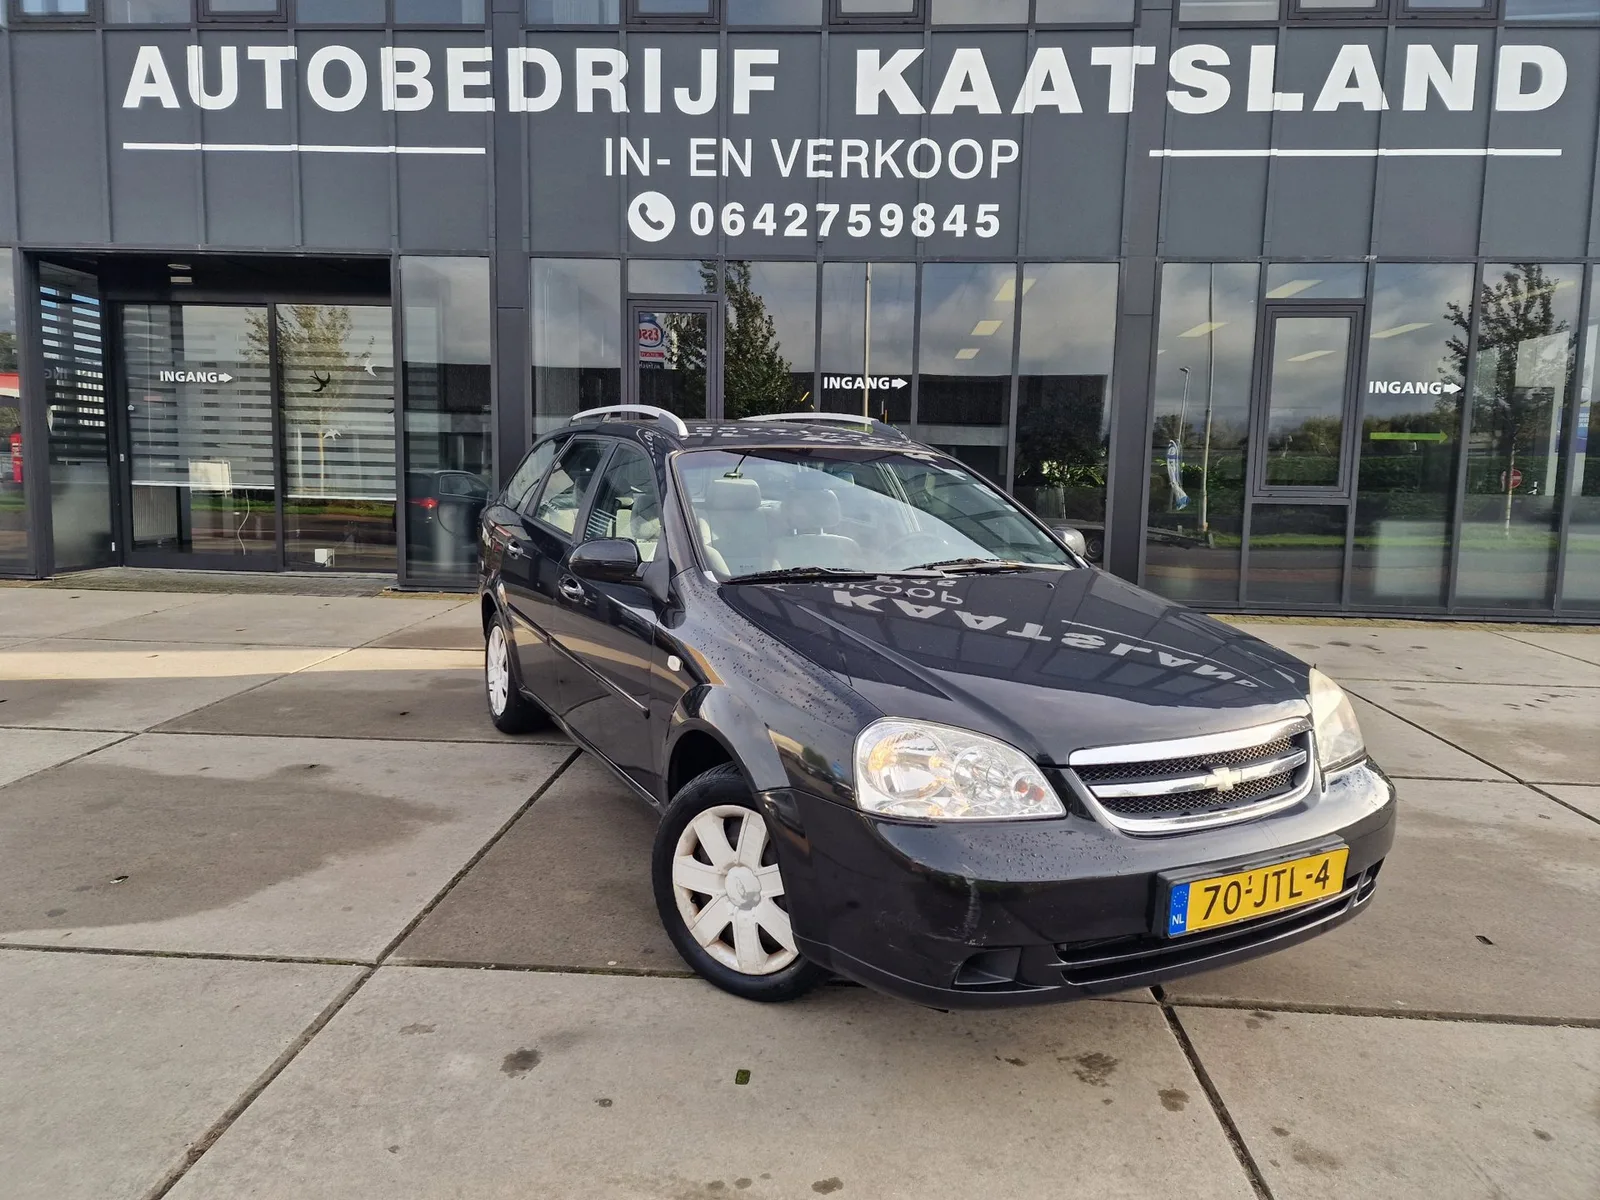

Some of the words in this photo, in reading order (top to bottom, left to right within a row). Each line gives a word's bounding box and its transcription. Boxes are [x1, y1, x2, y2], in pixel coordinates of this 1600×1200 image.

[123, 44, 780, 116] AUTOBEDRIJF
[855, 43, 1568, 116] KAATSLAND
[605, 136, 671, 177] IN-
[689, 137, 752, 178] EN
[771, 137, 1020, 180] VERKOOP
[689, 201, 1000, 239] 0642759845
[159, 370, 218, 383] INGANG
[822, 376, 890, 390] INGANG
[1368, 380, 1442, 395] INGANG
[1171, 914, 1185, 926] NL
